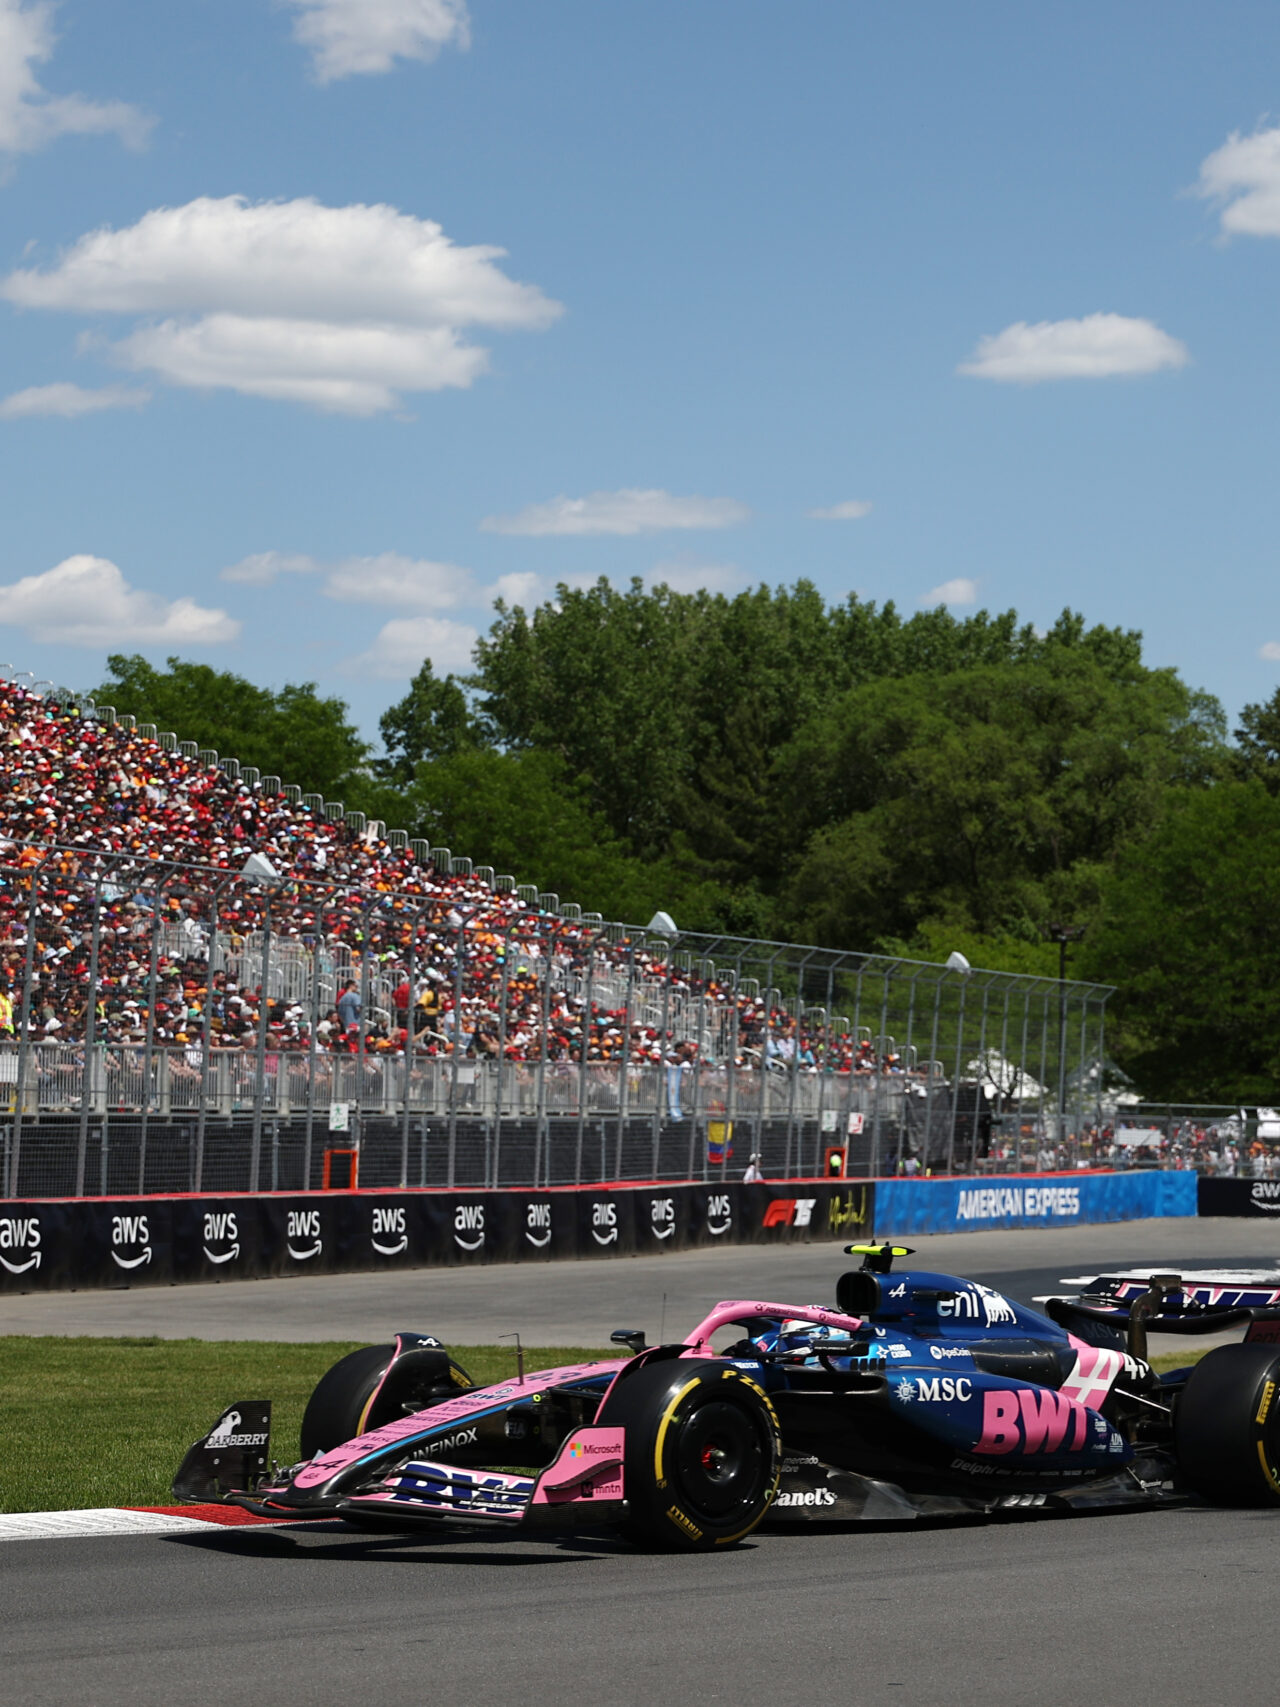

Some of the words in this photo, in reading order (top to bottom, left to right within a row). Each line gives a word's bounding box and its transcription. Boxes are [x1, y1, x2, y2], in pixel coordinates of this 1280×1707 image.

[527, 1203, 550, 1227] aws
[592, 1202, 617, 1225] aws
[651, 1198, 675, 1221] aws
[707, 1195, 730, 1217] aws
[956, 1188, 1023, 1219] AMERICAN
[1025, 1187, 1080, 1216] EXPRESS
[112, 1215, 150, 1244] aws
[204, 1212, 238, 1240] aws
[288, 1210, 321, 1237] aws
[372, 1208, 406, 1233] aws
[454, 1205, 484, 1230] aws
[0, 1218, 41, 1248] aws
[937, 1284, 979, 1318] eni
[915, 1378, 973, 1402] MSC
[971, 1389, 1088, 1455] BWT
[206, 1433, 268, 1447] OAKBERRY
[413, 1427, 478, 1459] INFINOX
[583, 1443, 621, 1454] Microsoft
